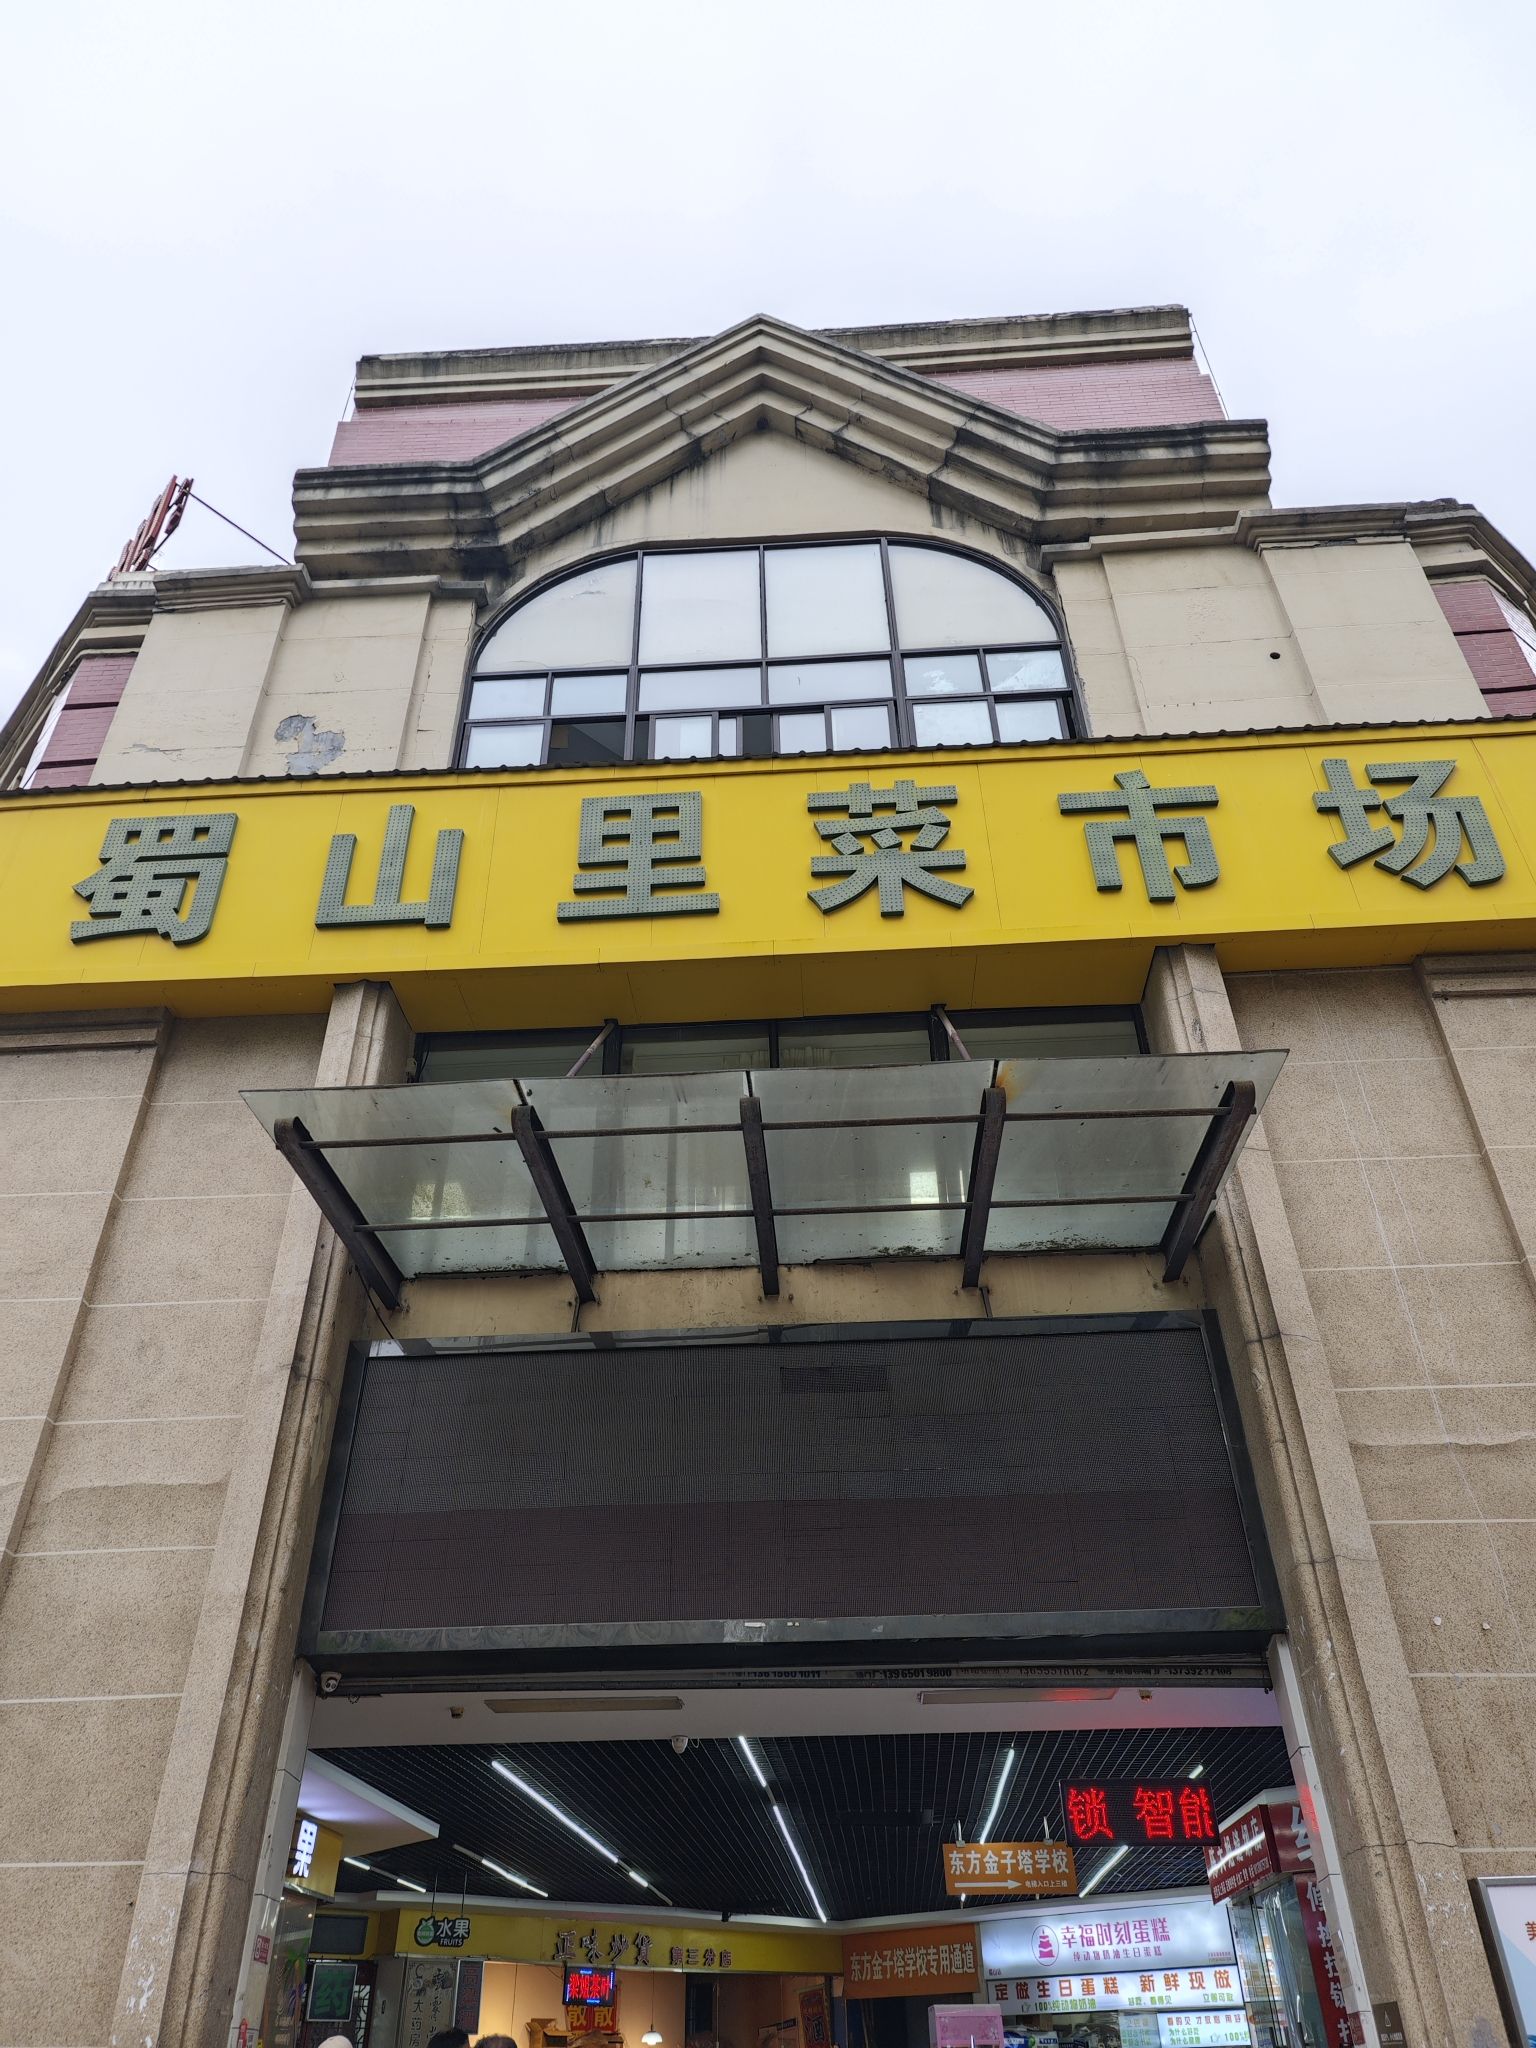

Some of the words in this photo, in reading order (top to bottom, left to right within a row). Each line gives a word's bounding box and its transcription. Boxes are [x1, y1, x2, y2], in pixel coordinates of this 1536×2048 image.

[70, 758, 1506, 948] 蜀山里菜市场
[292, 1820, 318, 1878] 果
[949, 1849, 1069, 1875] 东方金子塔学校
[436, 1918, 469, 1938] 水果
[440, 1938, 463, 1946] FRUITS
[1060, 1917, 1171, 1949] 幸福时刻蛋糕
[850, 1942, 976, 1982] 东方金子塔学校专用通道
[995, 1976, 1120, 2001] 定做生日蛋糕
[1139, 1969, 1232, 1993] 新鲜现做
